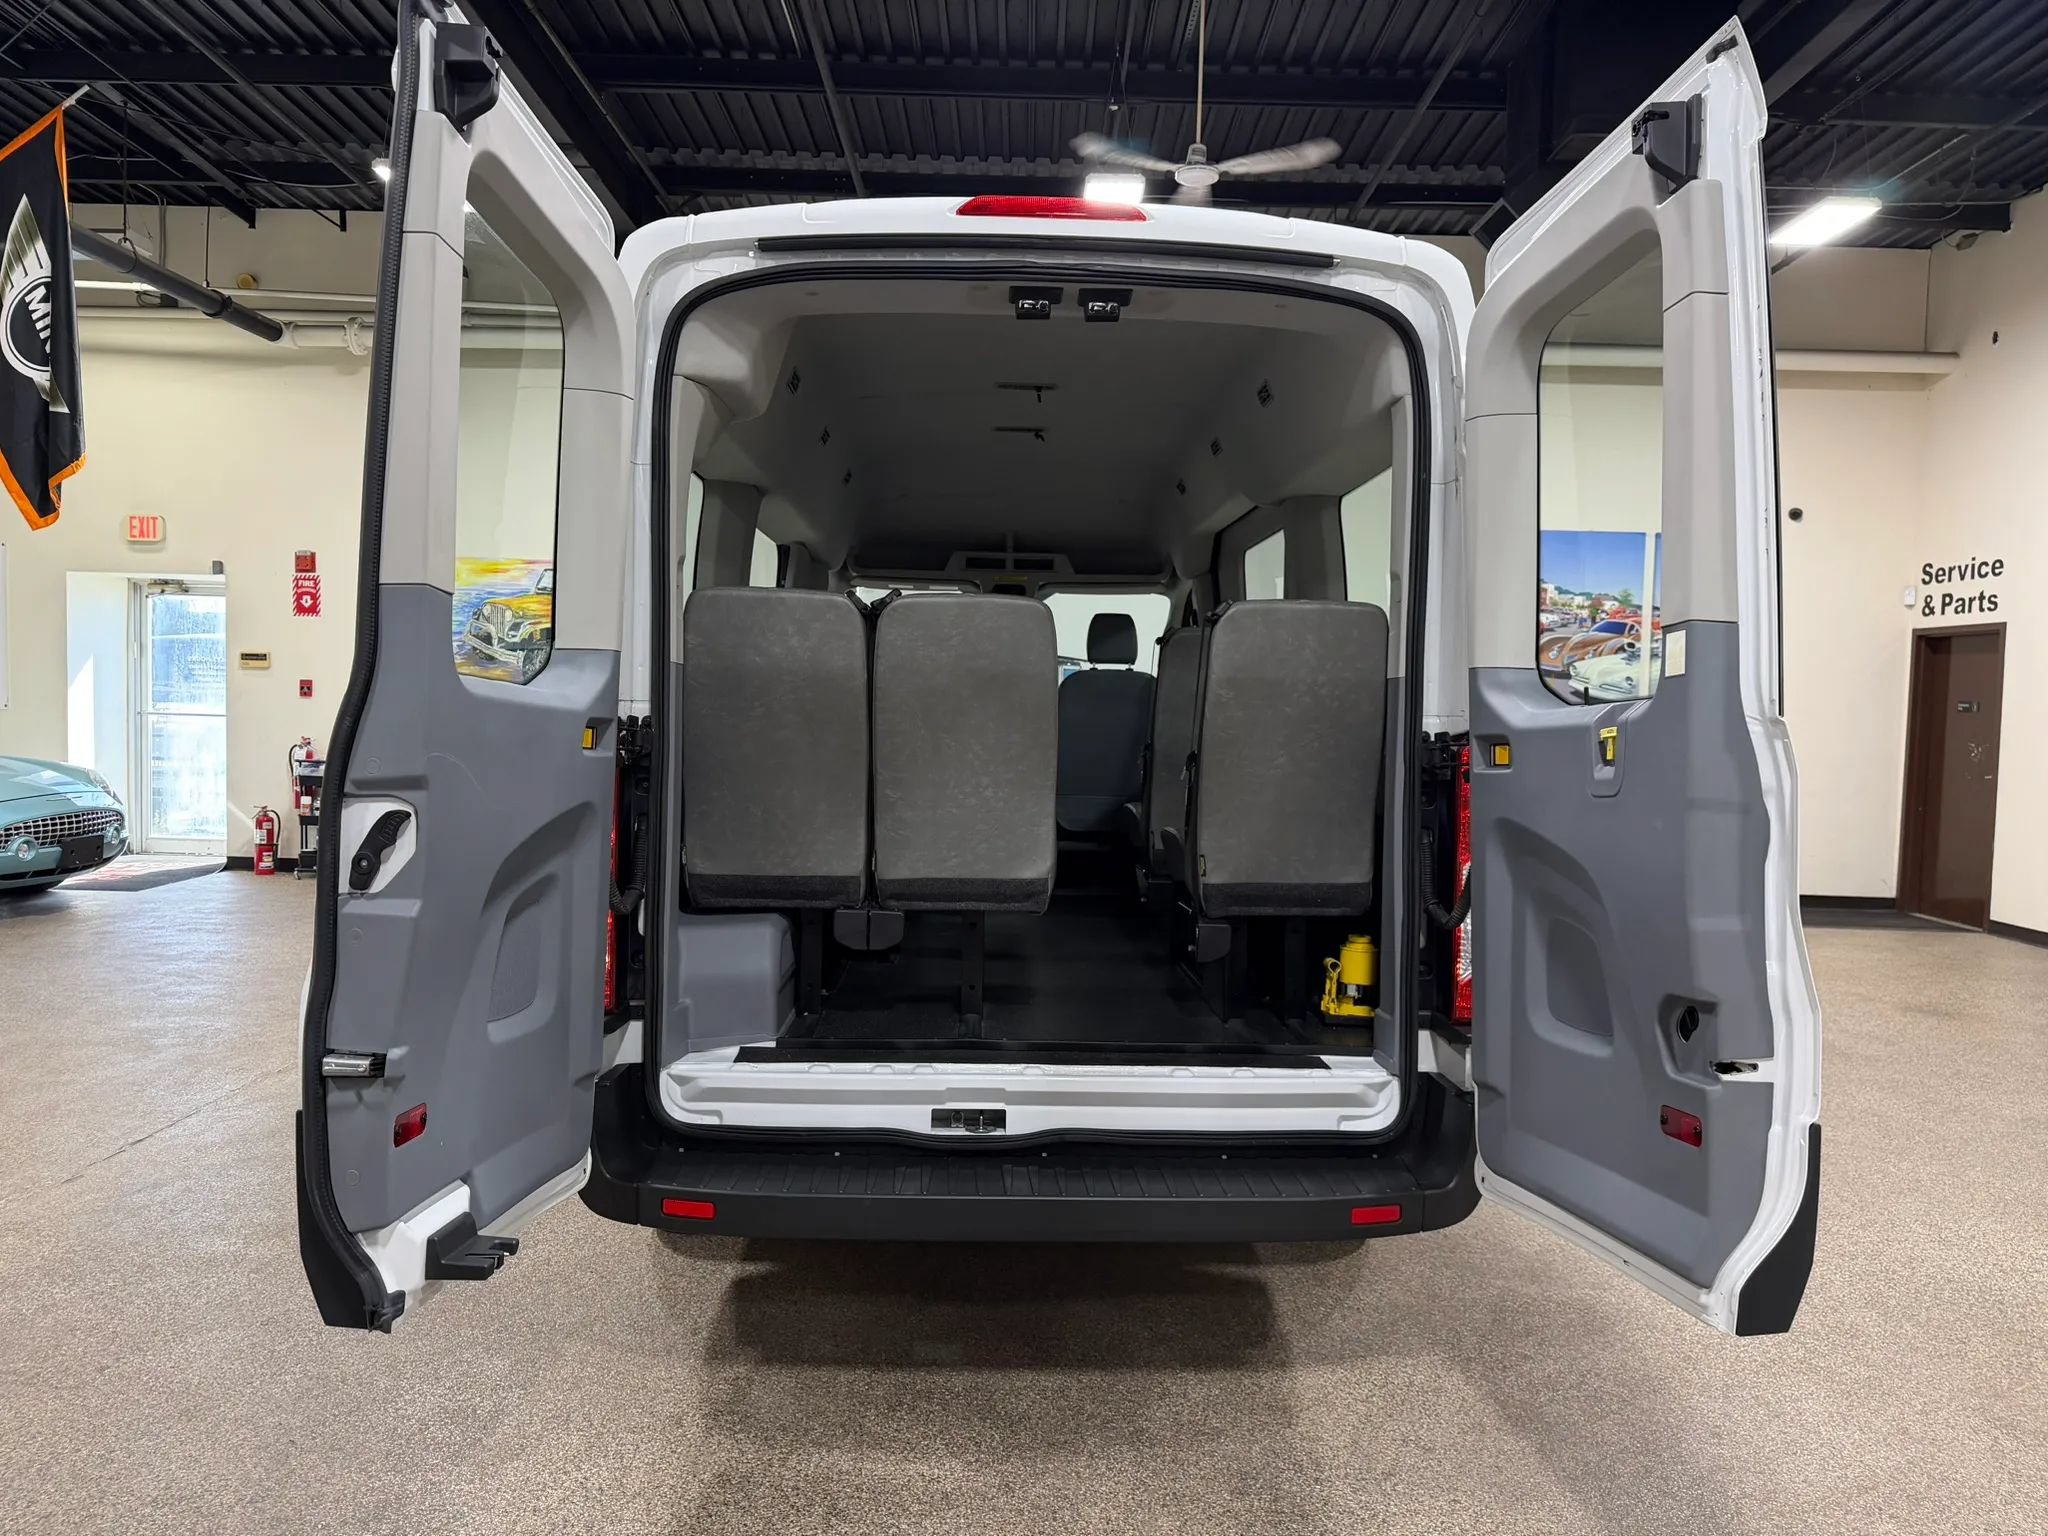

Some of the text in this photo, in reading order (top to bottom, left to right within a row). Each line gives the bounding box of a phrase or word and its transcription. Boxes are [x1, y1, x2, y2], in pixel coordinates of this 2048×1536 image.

[129, 515, 159, 539] EXIT
[1921, 556, 2004, 585] Service
[1921, 590, 1998, 617] & Parts
